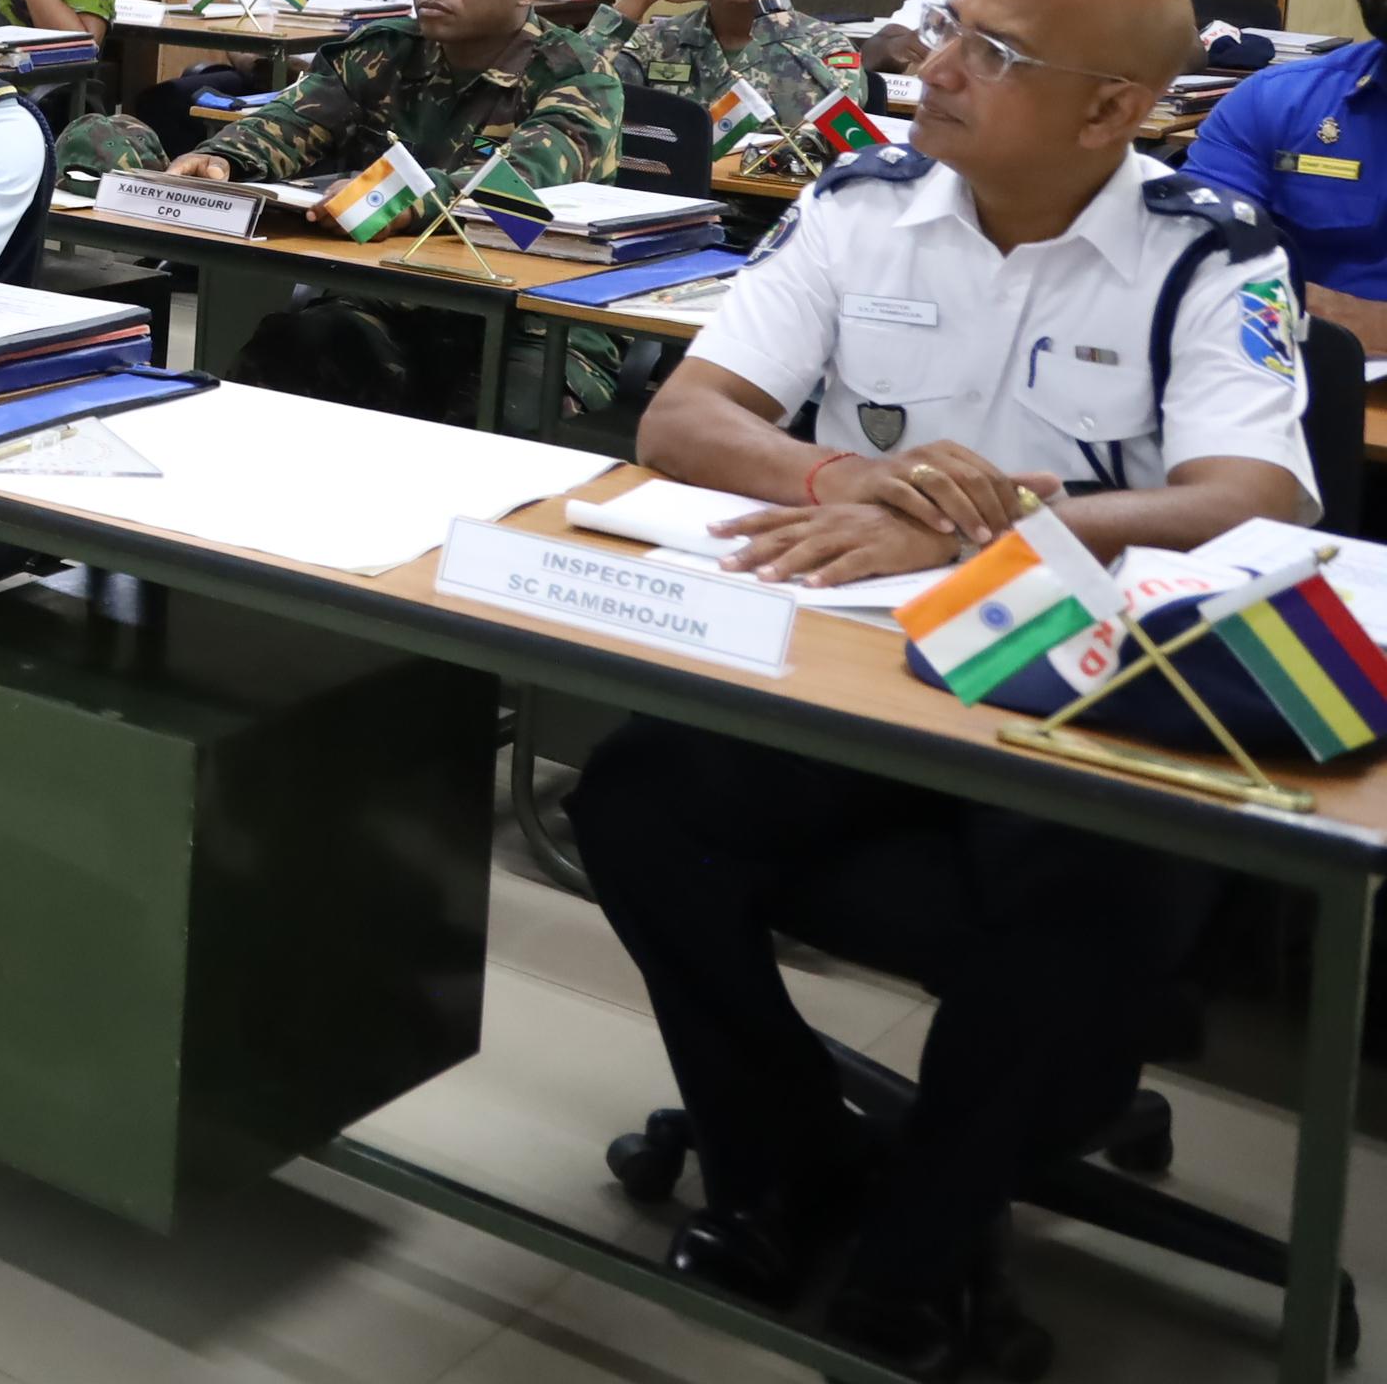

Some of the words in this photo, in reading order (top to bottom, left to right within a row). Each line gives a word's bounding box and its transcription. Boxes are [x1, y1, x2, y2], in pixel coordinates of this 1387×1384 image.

[886, 79, 912, 87] ABLE
[887, 89, 908, 97] TOU
[118, 183, 164, 199] XAVERY
[166, 192, 233, 211] NDUNGURU
[157, 206, 181, 218] CPO
[542, 551, 686, 601] INSPECTOR
[508, 573, 541, 596] SC
[547, 584, 709, 638] RAMBHOJUN
